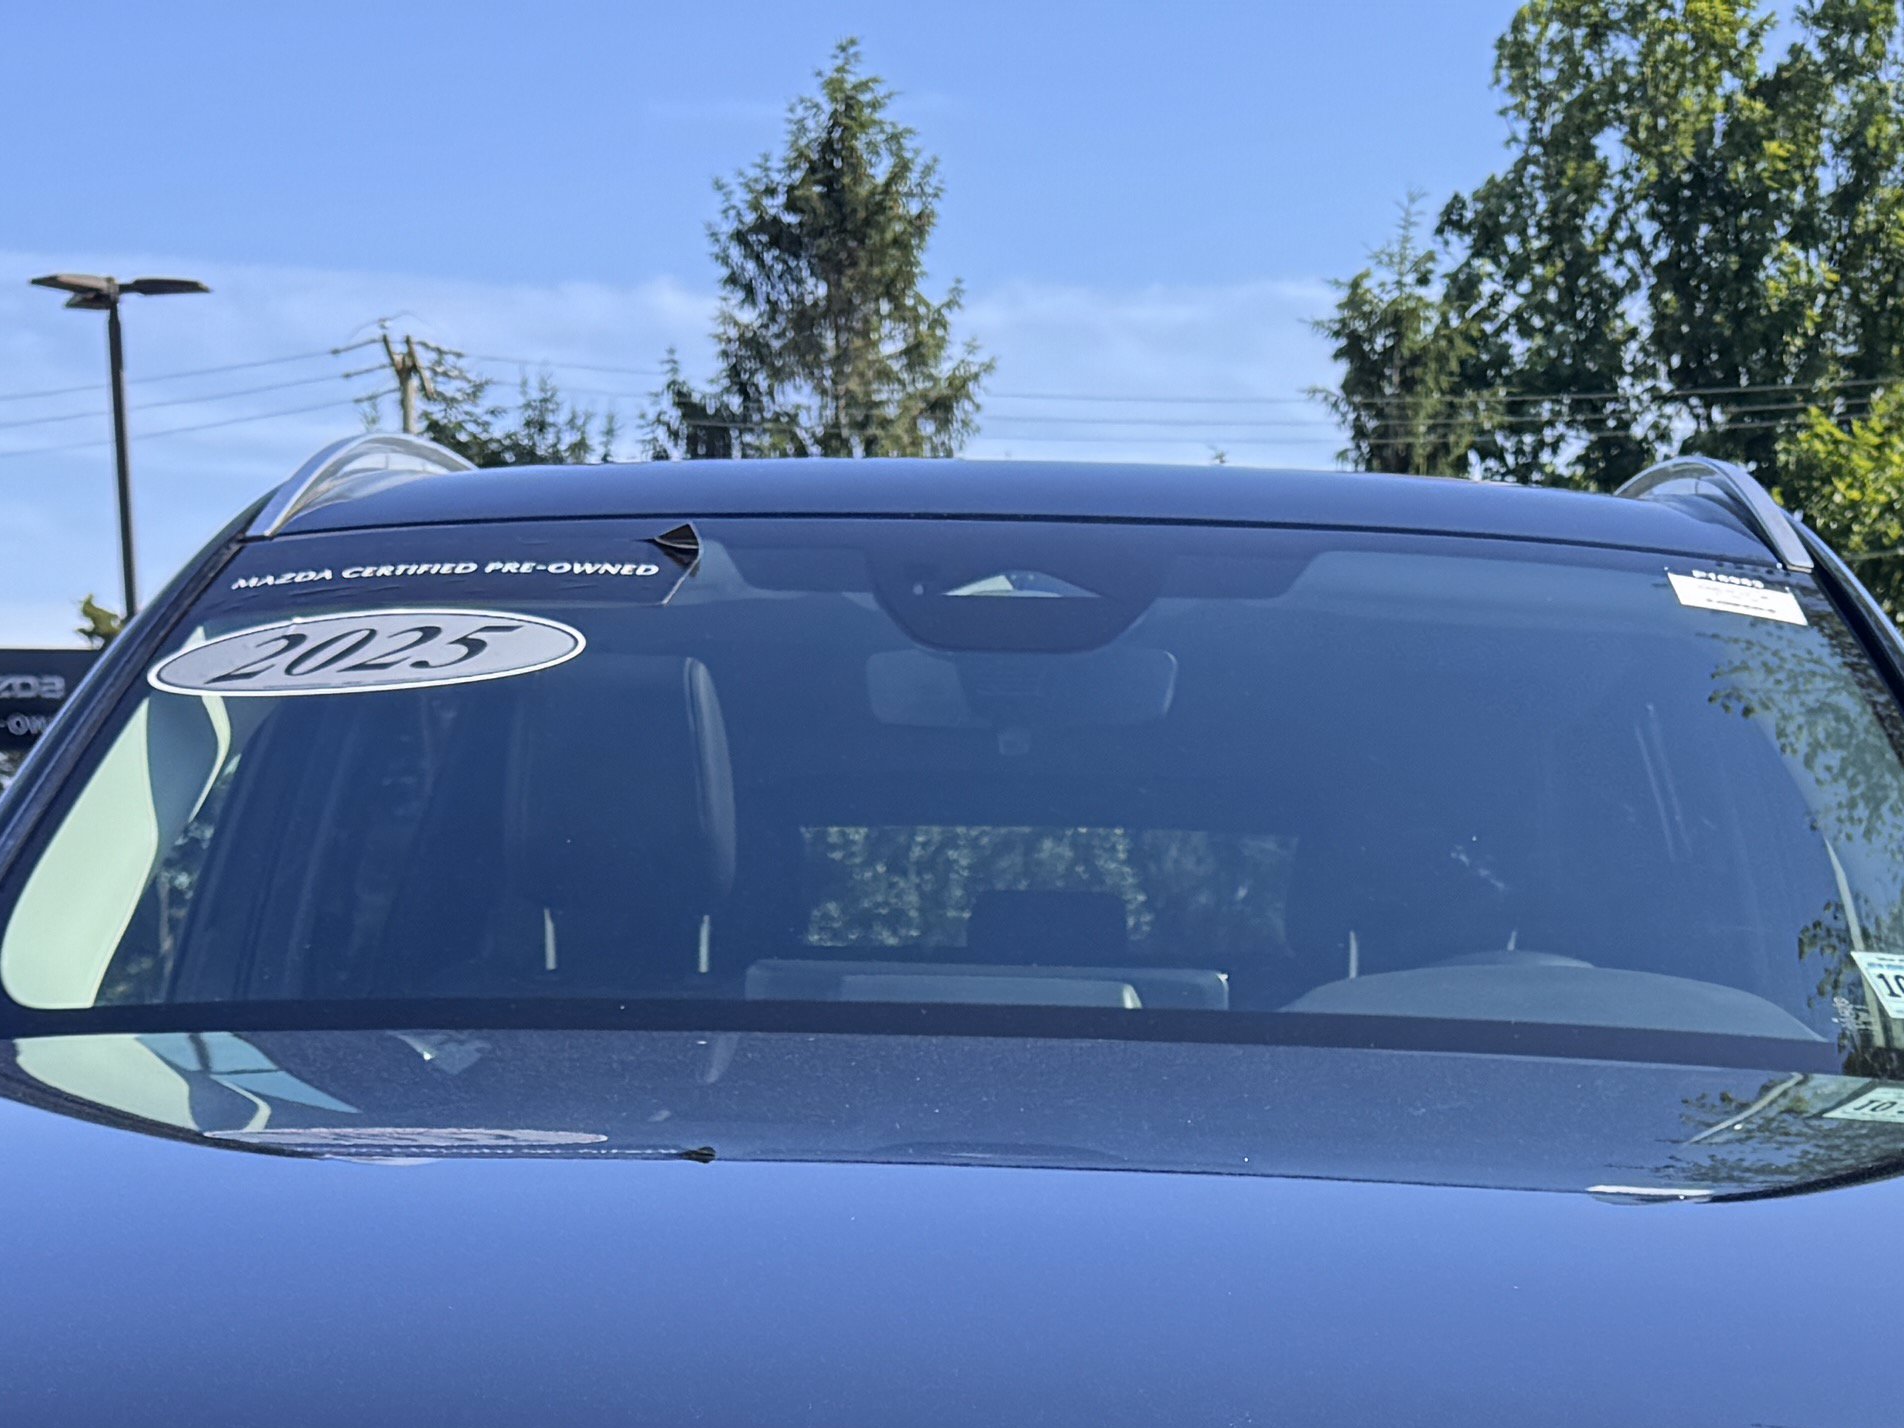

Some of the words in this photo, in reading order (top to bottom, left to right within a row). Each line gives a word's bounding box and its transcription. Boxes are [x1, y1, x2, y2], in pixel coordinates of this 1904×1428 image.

[231, 568, 333, 590] MAZDA
[341, 561, 478, 580] CERTIFIED
[483, 560, 660, 577] PRE-OWNED
[204, 624, 524, 686] 2025
